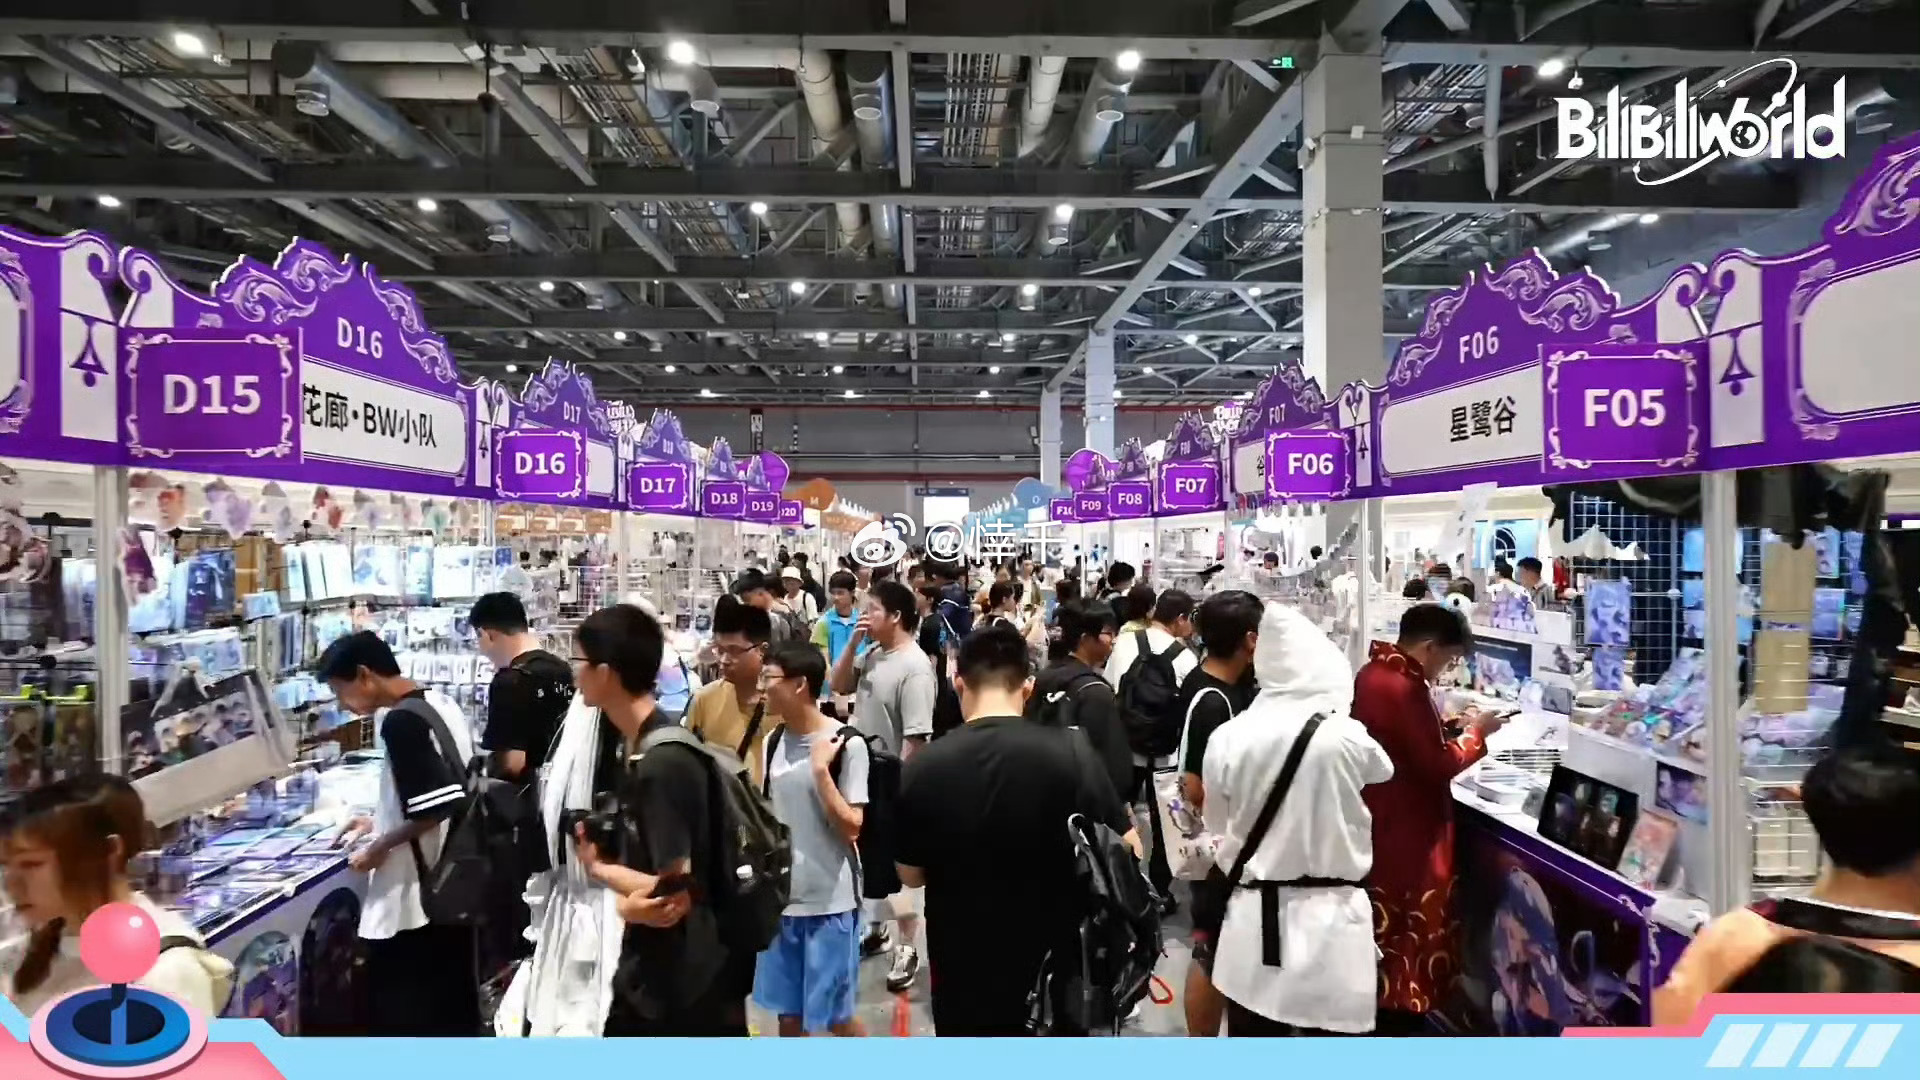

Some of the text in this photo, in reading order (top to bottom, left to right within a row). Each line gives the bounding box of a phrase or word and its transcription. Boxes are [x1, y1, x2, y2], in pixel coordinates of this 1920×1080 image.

[337, 317, 383, 359] D16
[1459, 326, 1499, 364] F06
[163, 374, 261, 414] D15
[563, 401, 581, 424] D17
[1269, 403, 1286, 426] F07
[1450, 396, 1517, 442] 星鹭谷
[1583, 388, 1666, 428] F05
[514, 451, 566, 475] D16
[1288, 452, 1334, 475] F06
[640, 477, 676, 494] D17
[1175, 477, 1207, 494] F07
[711, 492, 738, 505] D18
[751, 501, 774, 511] D19
[1081, 500, 1101, 511] F09
[1117, 492, 1143, 505] F08
